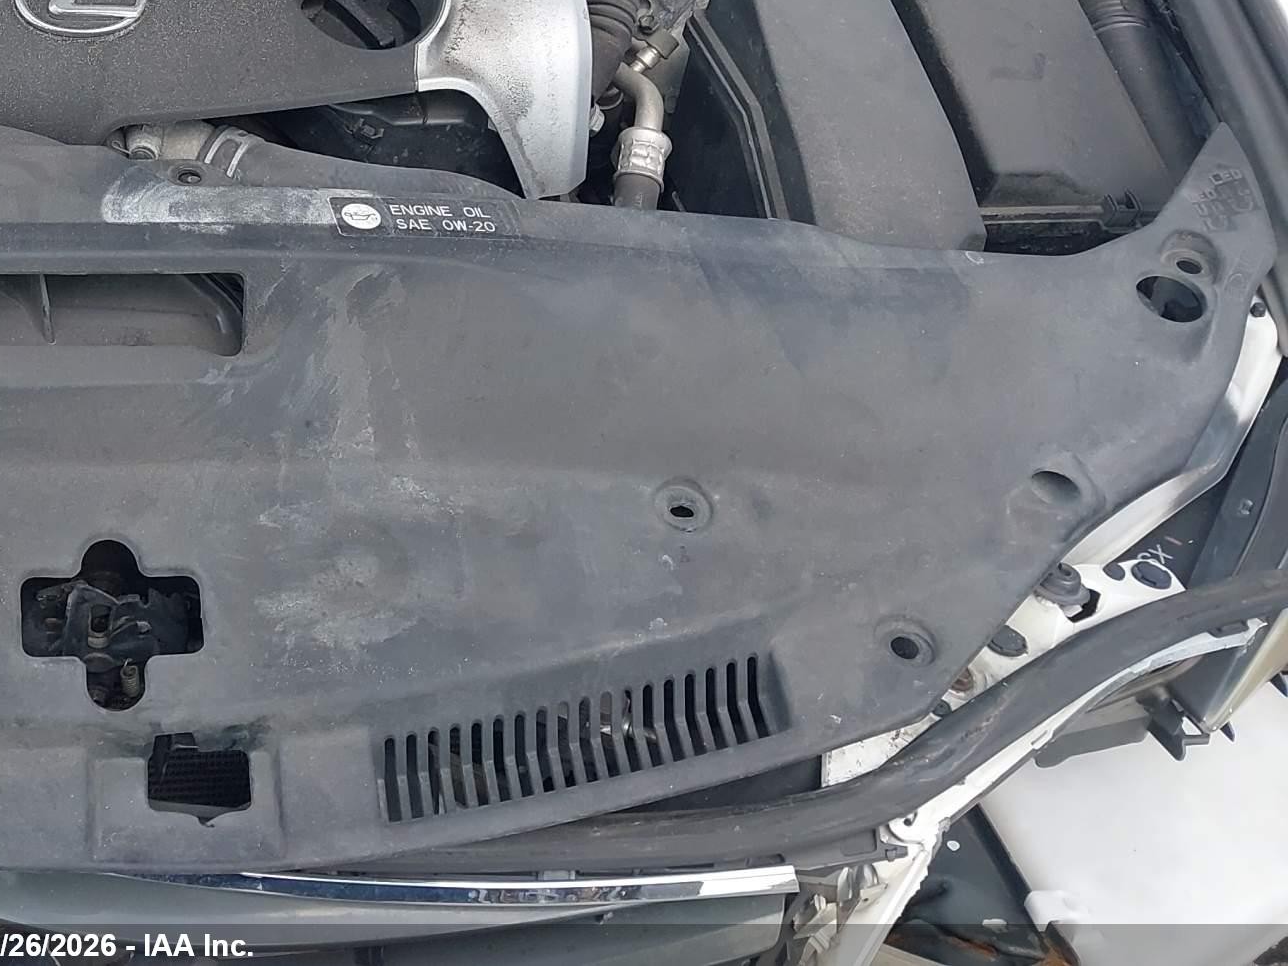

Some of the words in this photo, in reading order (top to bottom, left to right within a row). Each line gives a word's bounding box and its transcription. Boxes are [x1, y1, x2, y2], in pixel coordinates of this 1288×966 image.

[389, 204, 453, 217] ENGINE
[463, 206, 491, 218] OIL
[396, 218, 432, 230] SAE
[442, 219, 496, 232] 0W-20
